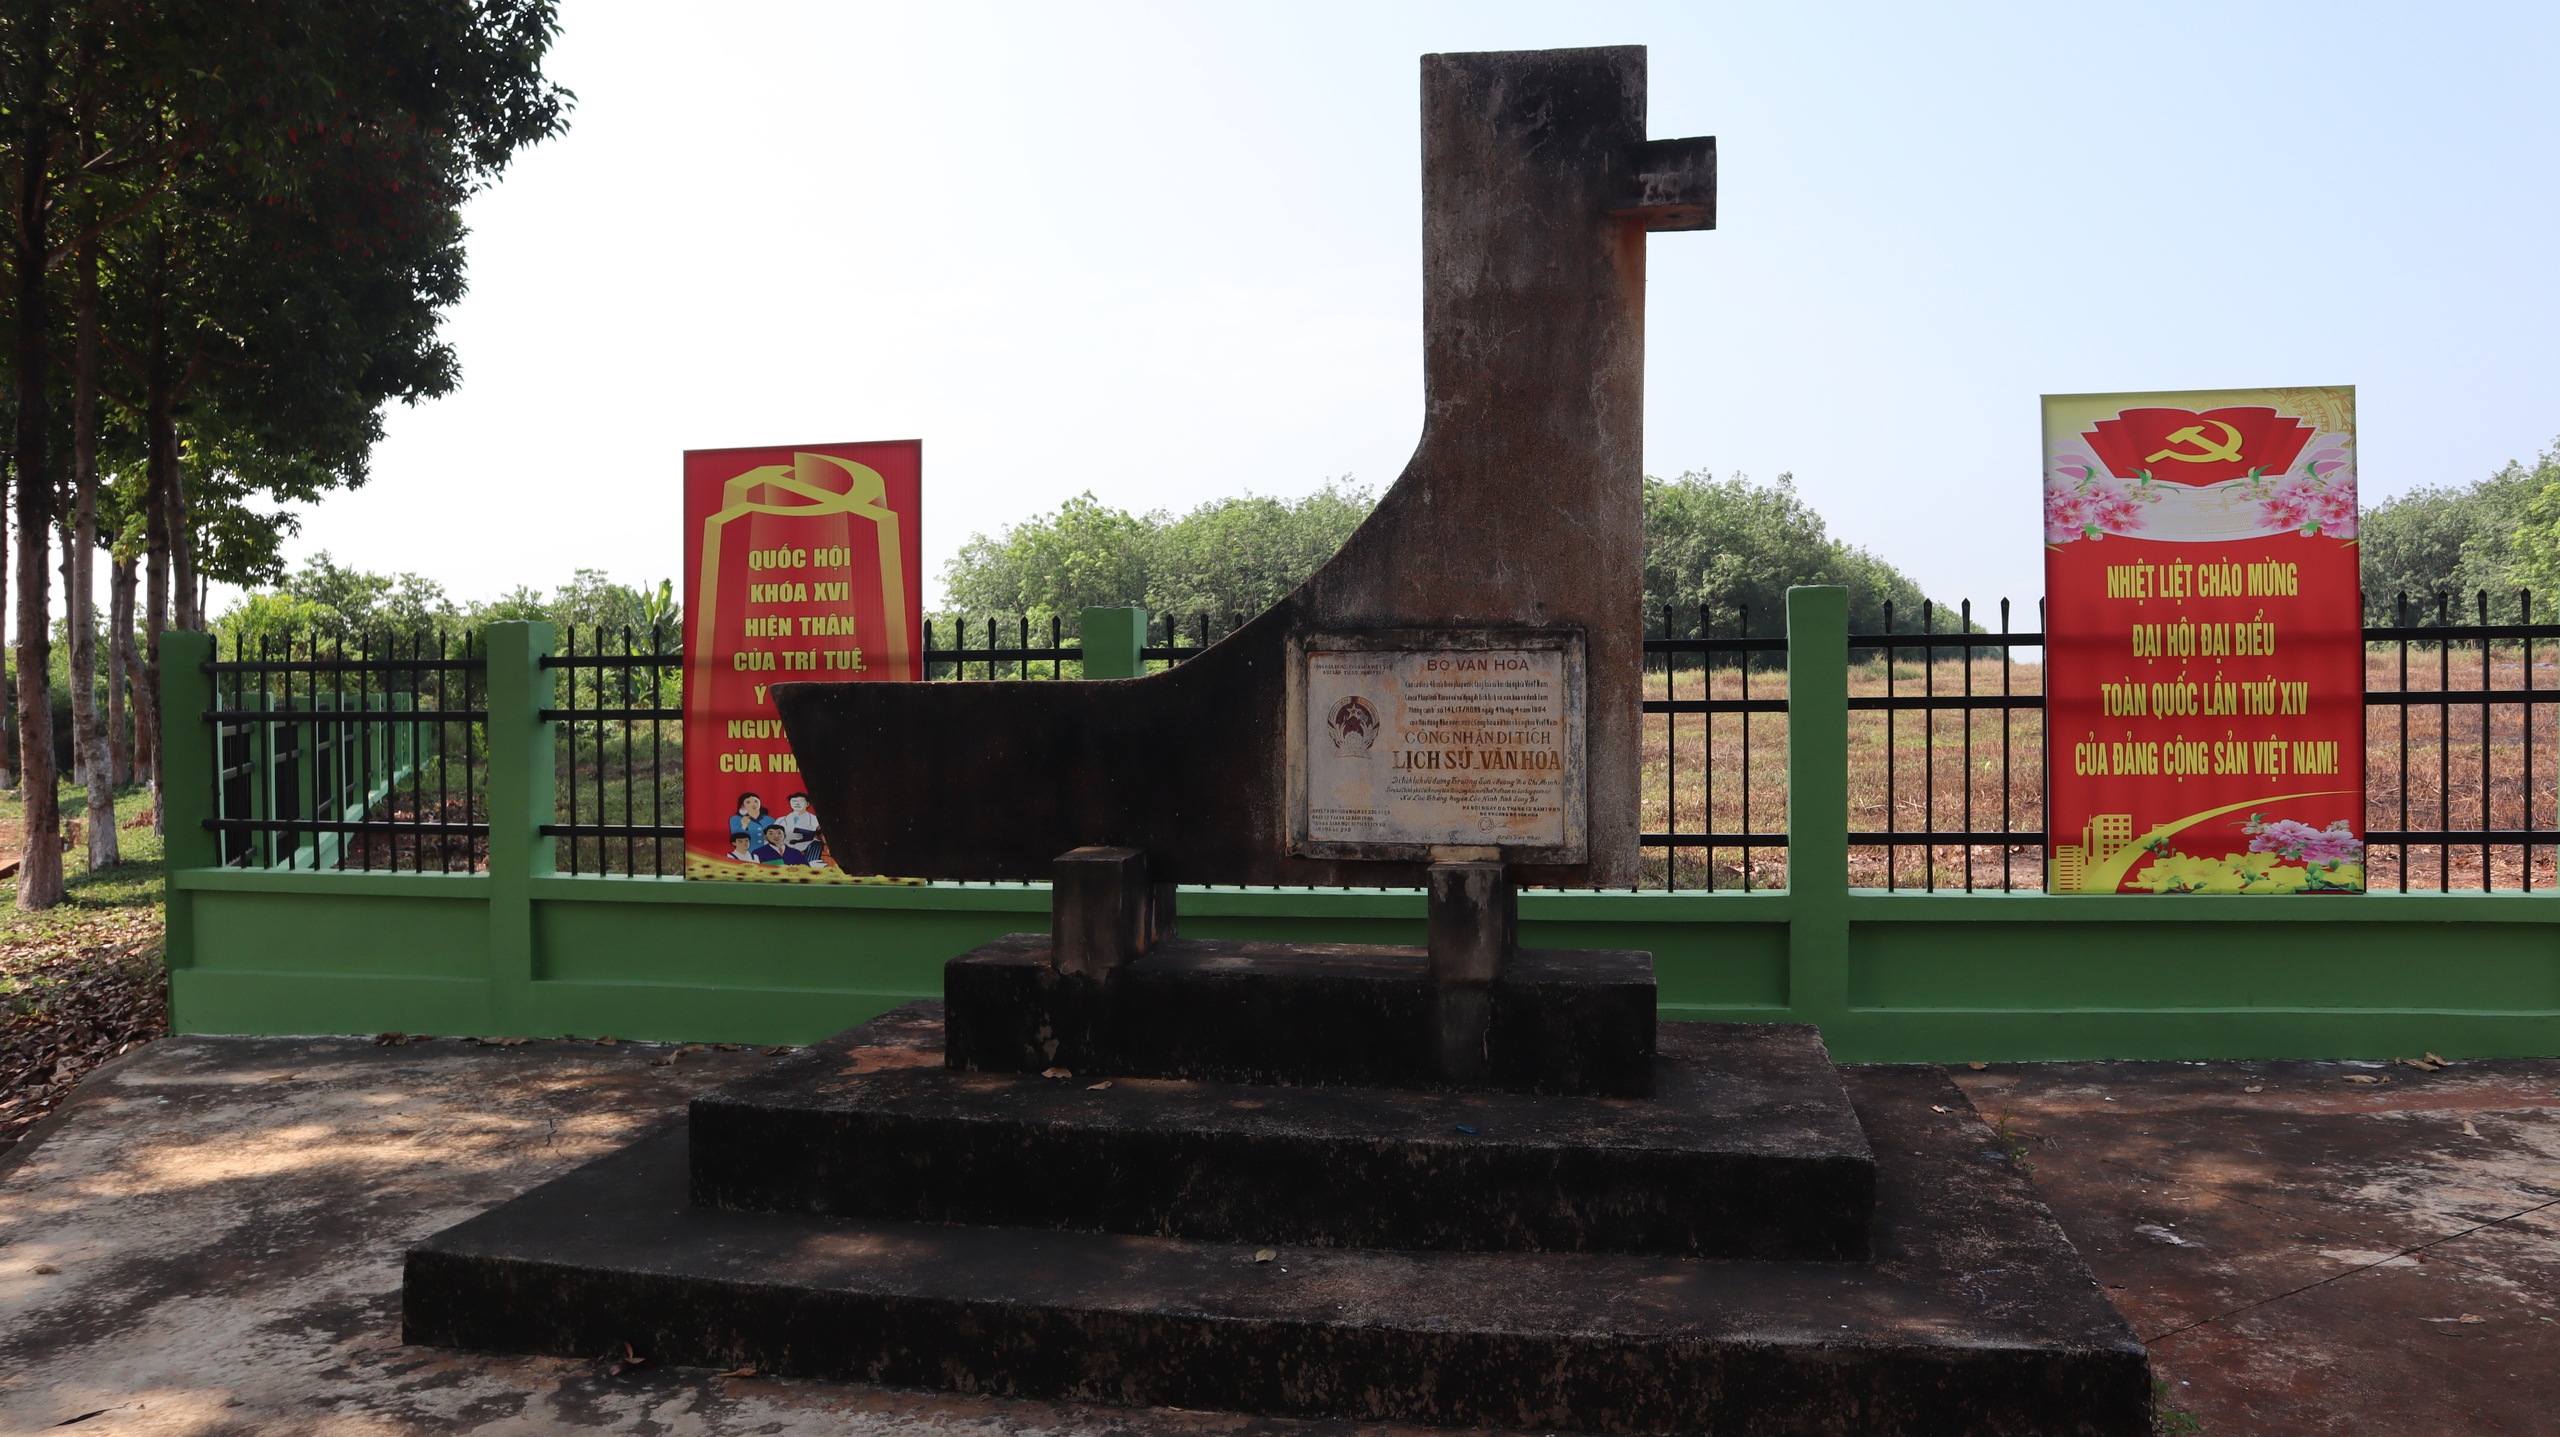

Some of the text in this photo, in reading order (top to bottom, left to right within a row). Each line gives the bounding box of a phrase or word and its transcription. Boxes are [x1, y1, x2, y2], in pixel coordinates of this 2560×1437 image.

[748, 543, 851, 571] QUỐC HỘI
[750, 580, 849, 603] KHÓA XVI
[2107, 556, 2298, 606] NHIỆT LIỆT CHÀO MỪNG
[745, 613, 855, 640] HIỆN THÂN
[2132, 608, 2275, 665] ĐẠI HỘI ĐẠI BIỂU
[733, 647, 868, 673] CỦA TRÍ TUỆ,
[753, 682, 768, 705] Ý
[2101, 670, 2309, 720] TOÀN QUỐC LẦN THỨ XIV
[1497, 731, 1512, 745] DI
[719, 749, 800, 773] CỦA NH
[2075, 729, 2339, 783] CỦA ĐẢNG CỘNG SẢN VIỆT NAM!
